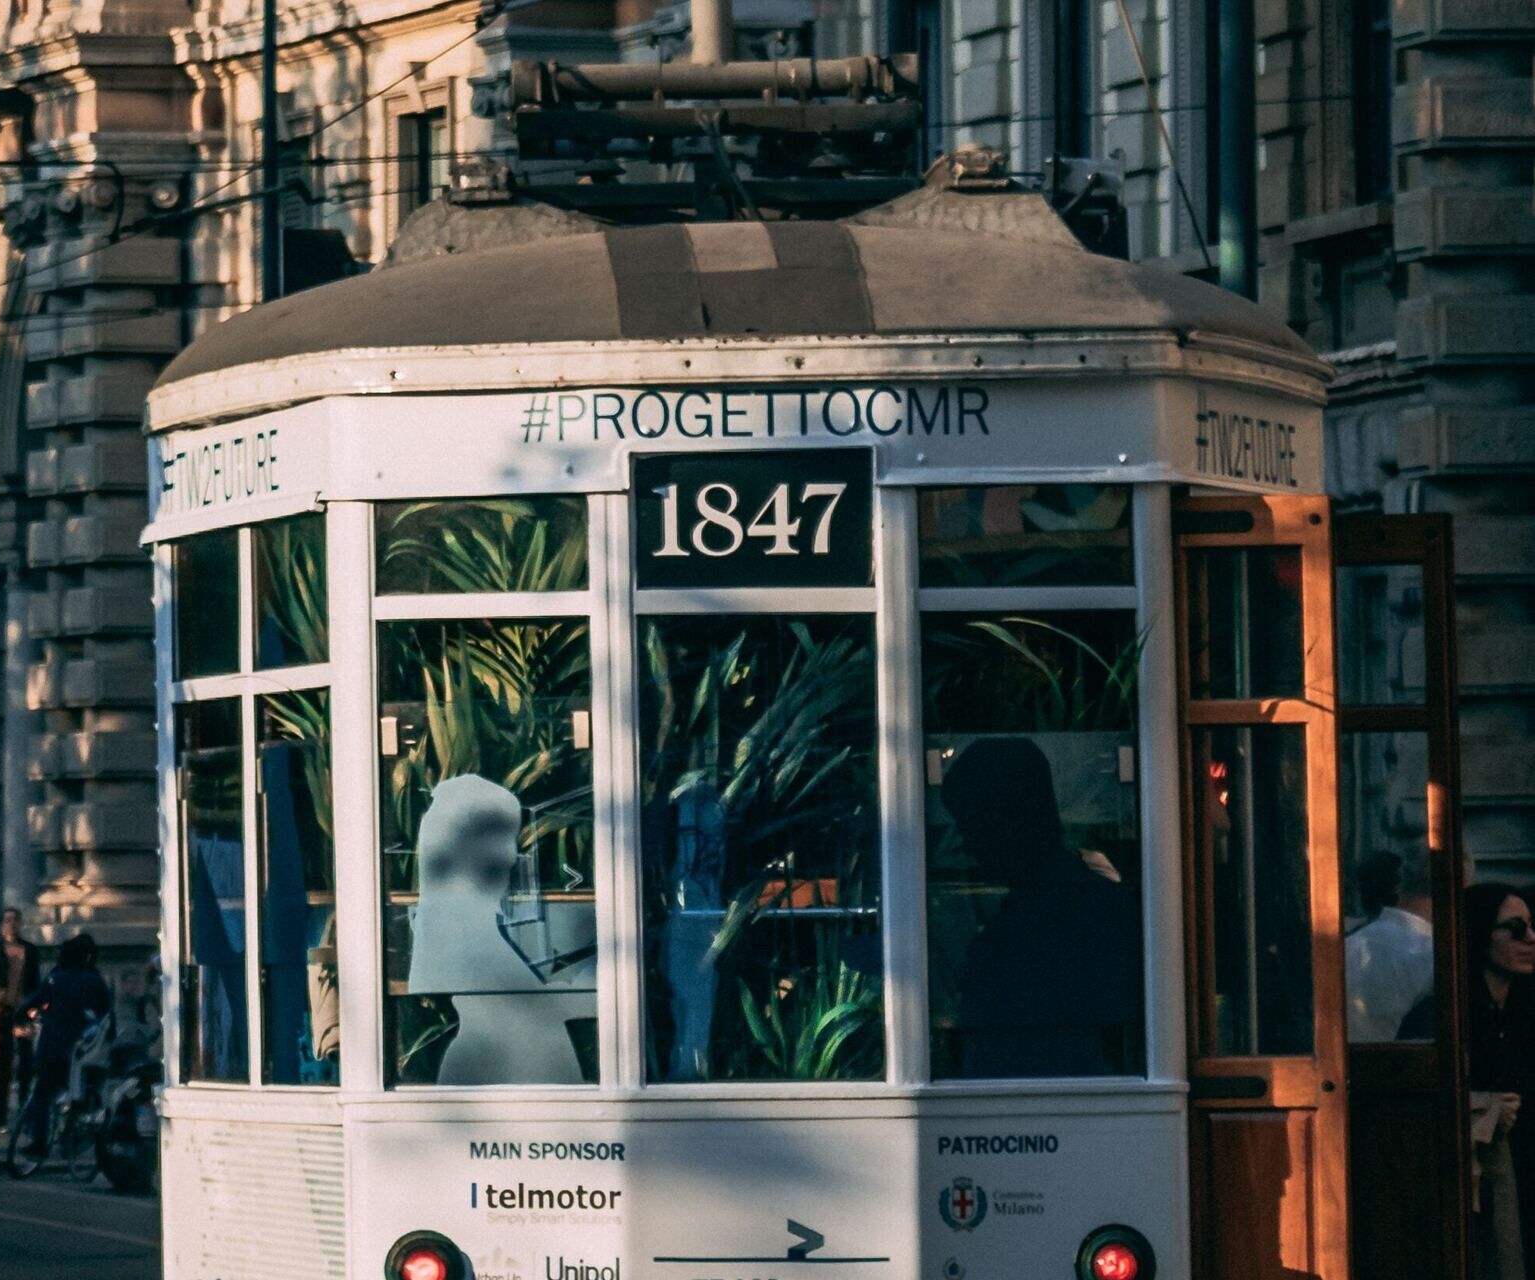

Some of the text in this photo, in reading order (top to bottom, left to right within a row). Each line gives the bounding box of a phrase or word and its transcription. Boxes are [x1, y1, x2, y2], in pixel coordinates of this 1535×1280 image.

[520, 386, 991, 443] #PROGETTOCMR
[1195, 390, 1297, 488] #TW2FUTURE
[162, 429, 279, 512] #TW2FUTURE
[651, 482, 847, 558] 1847
[470, 1141, 626, 1161] MAIN SPONSOR
[938, 1134, 1059, 1155] PATROCINIO
[486, 1183, 622, 1210] telmotor
[993, 1202, 1045, 1216] Milano
